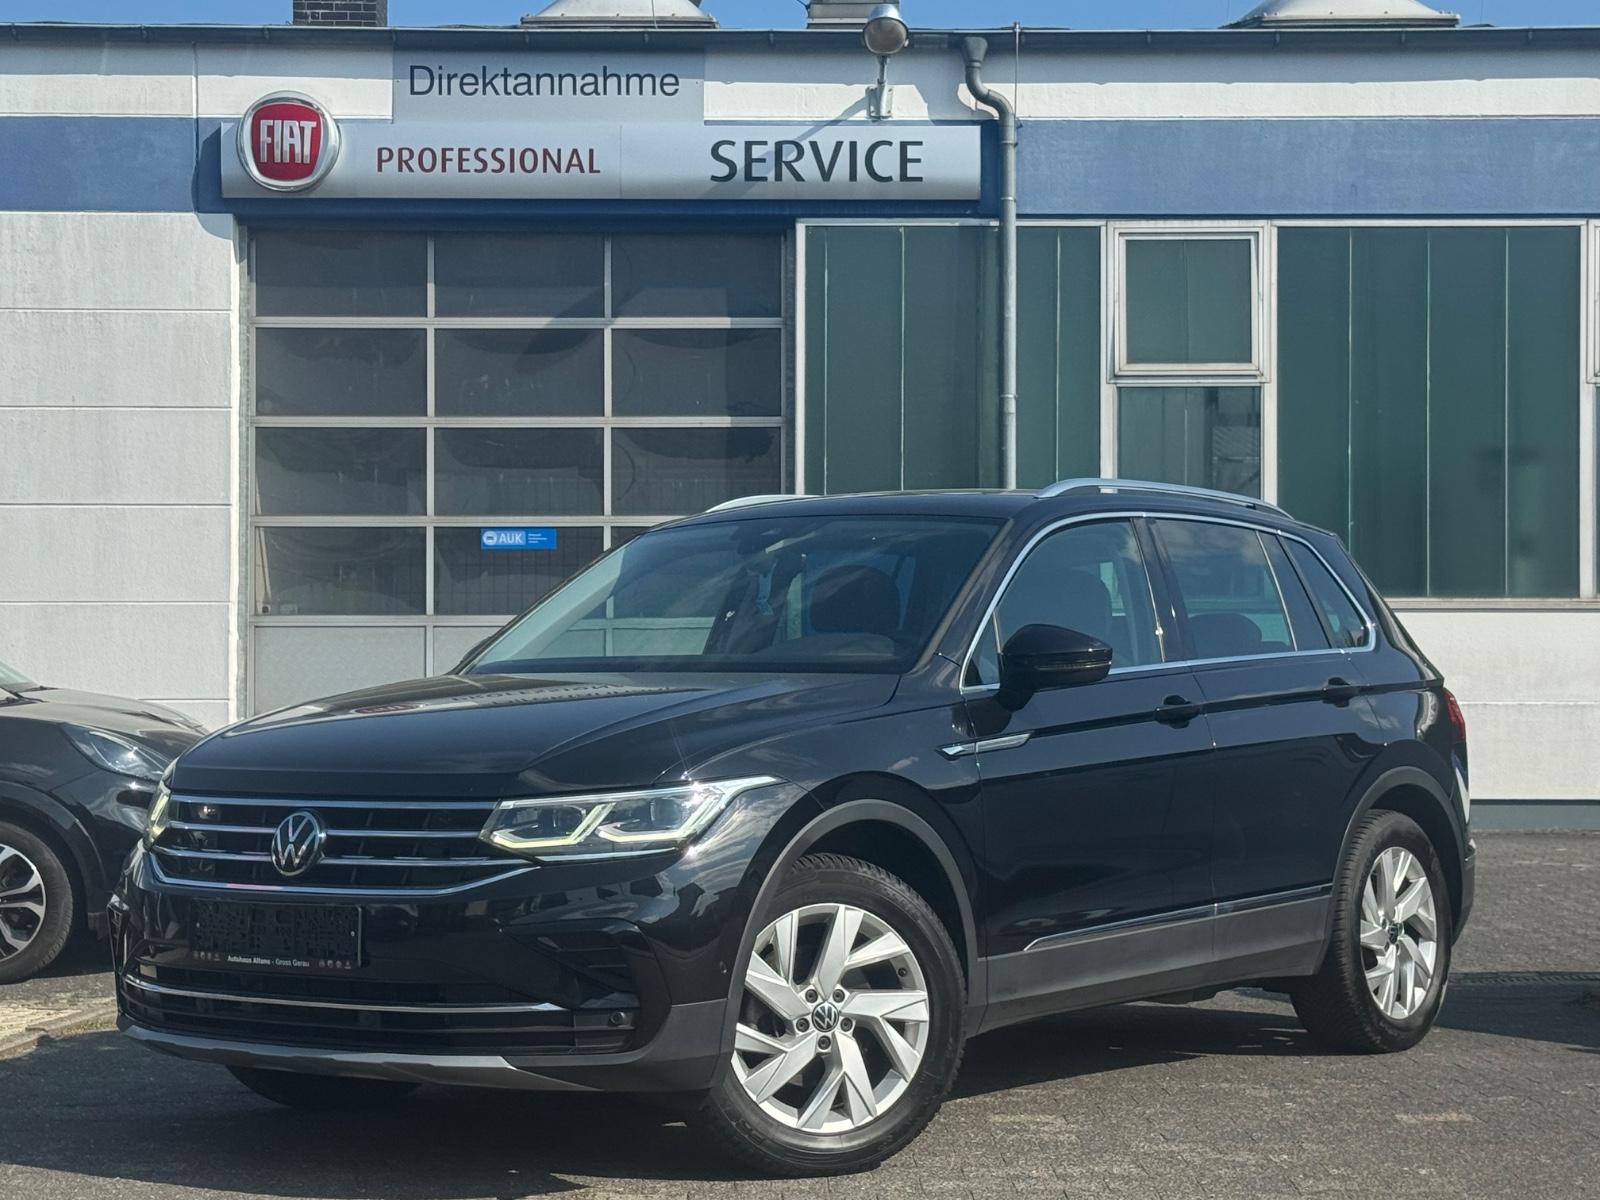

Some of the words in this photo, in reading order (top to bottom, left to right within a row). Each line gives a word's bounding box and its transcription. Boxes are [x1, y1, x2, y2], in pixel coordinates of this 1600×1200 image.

[409, 65, 680, 97] Direktannahme
[260, 119, 318, 165] FIAT
[376, 147, 601, 174] PROFESSIONAL
[710, 139, 924, 183] SERVICE
[499, 533, 523, 544] AUK
